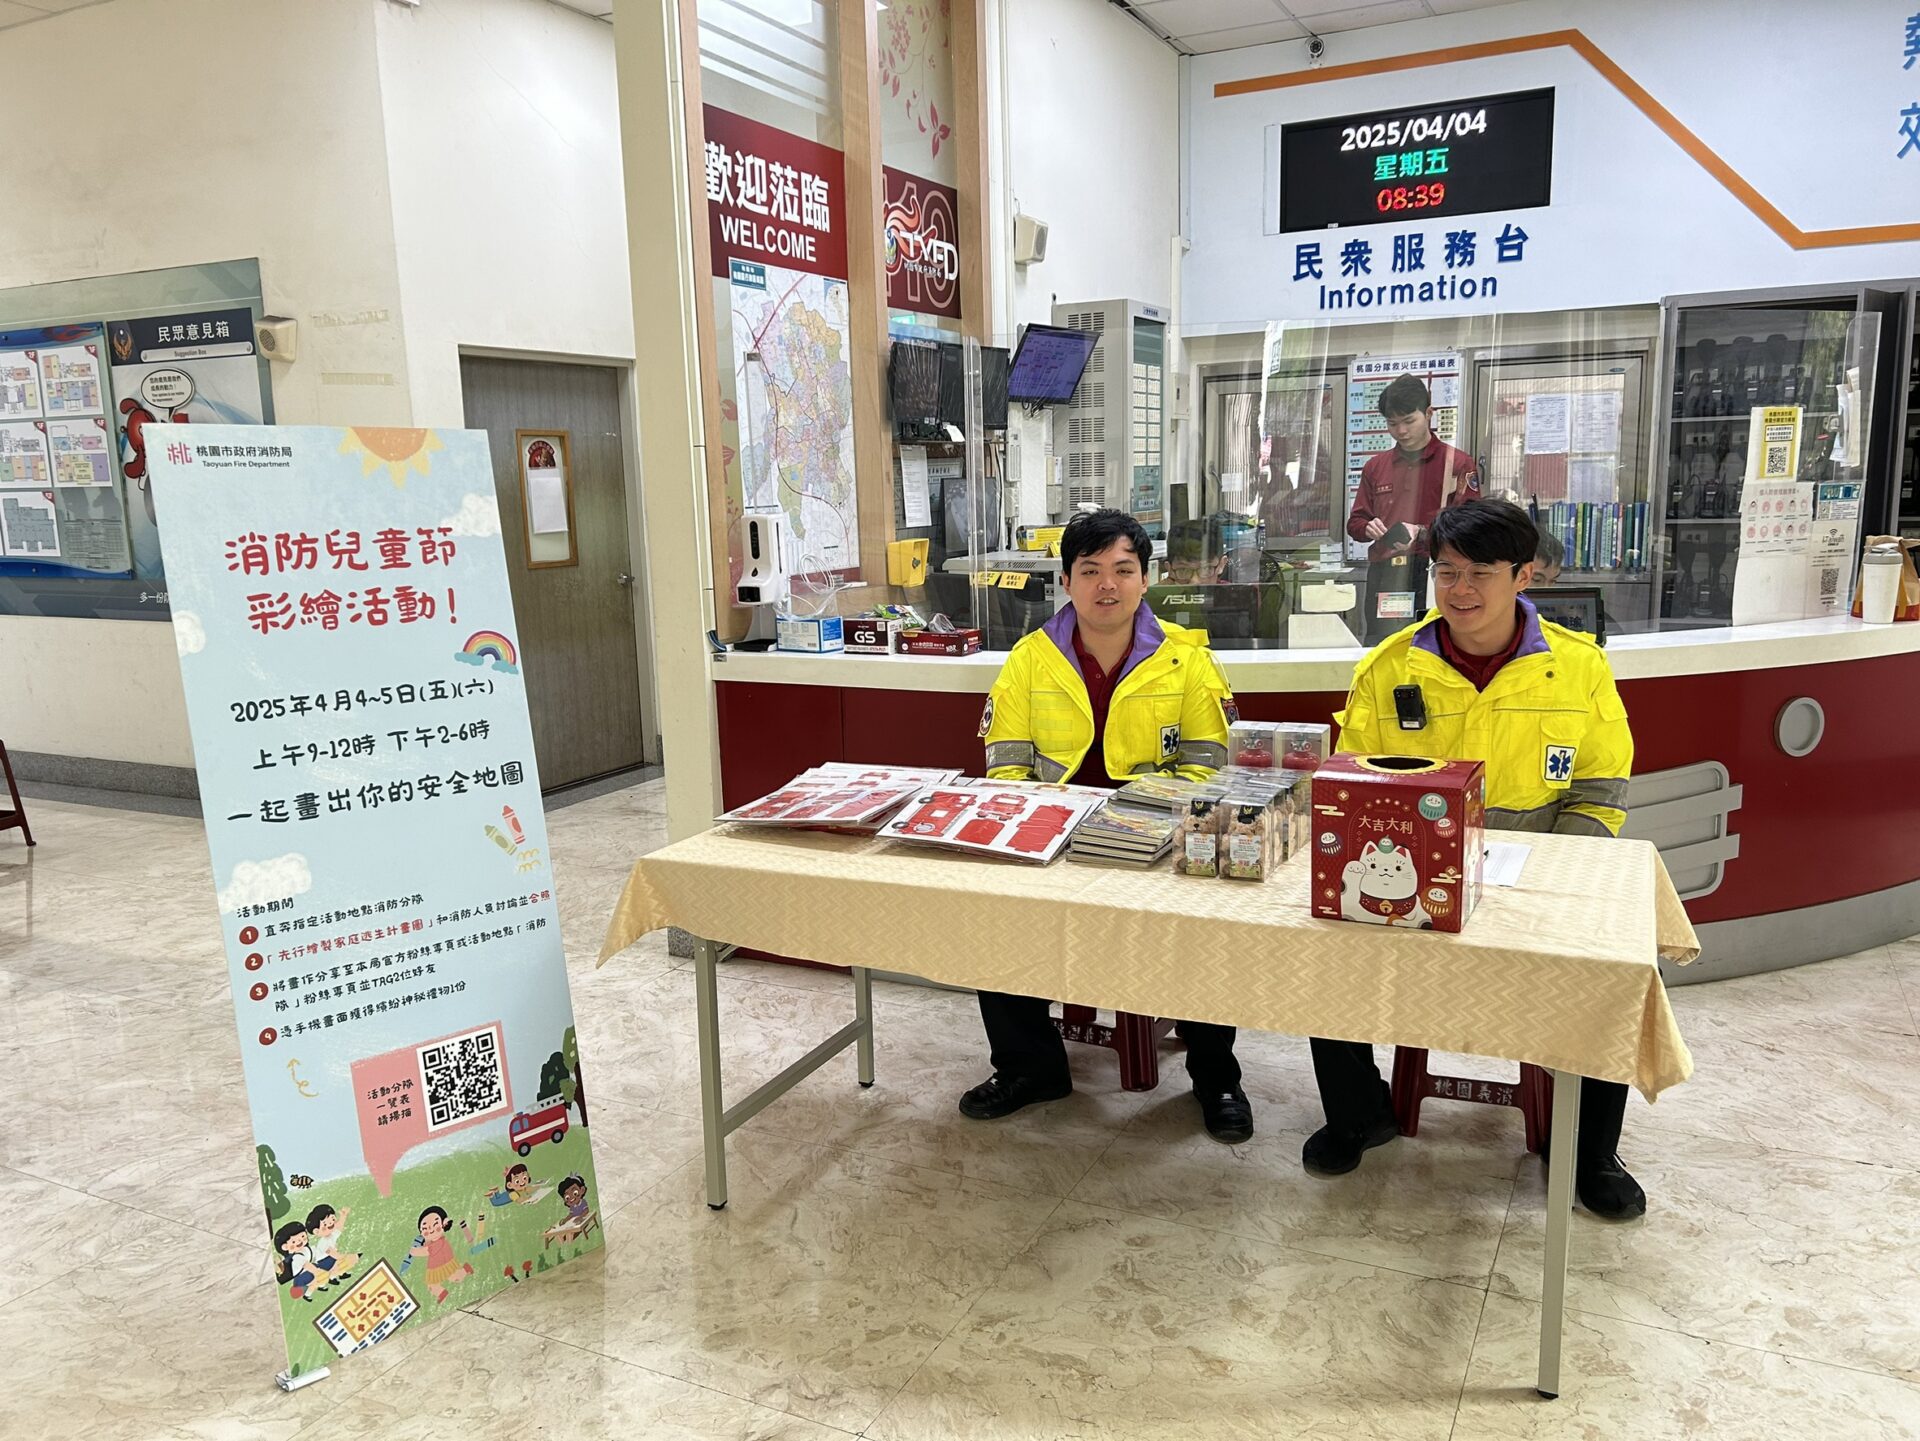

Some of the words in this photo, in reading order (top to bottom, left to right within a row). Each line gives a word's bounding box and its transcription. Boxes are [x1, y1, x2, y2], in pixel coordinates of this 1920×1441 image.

[1340, 109, 1487, 151] 2025/04/04
[1373, 147, 1450, 181] 星期五
[704, 141, 831, 233] 歡迎蒞臨
[1376, 182, 1446, 213] 08:39
[719, 214, 817, 263] WELCOME
[900, 230, 958, 281] TYFD
[1319, 276, 1498, 310] Information
[196, 445, 293, 457] 桃園市政府消防局
[202, 460, 232, 469] Taoyuan
[234, 460, 247, 468] Fire
[248, 460, 290, 469] Department
[224, 527, 458, 575] 消防兒童節
[1162, 594, 1205, 605] ASUS
[854, 631, 876, 644] GS
[227, 760, 524, 824] 一起畫出你的安全地圖
[1358, 815, 1413, 835] 大吉大利
[236, 897, 294, 919] 活動期間
[367, 1078, 414, 1100] 活動分隊
[376, 1093, 411, 1110] 一覽表
[1434, 1080, 1513, 1106] 桃園義消
[377, 1107, 412, 1126] 請掃描
